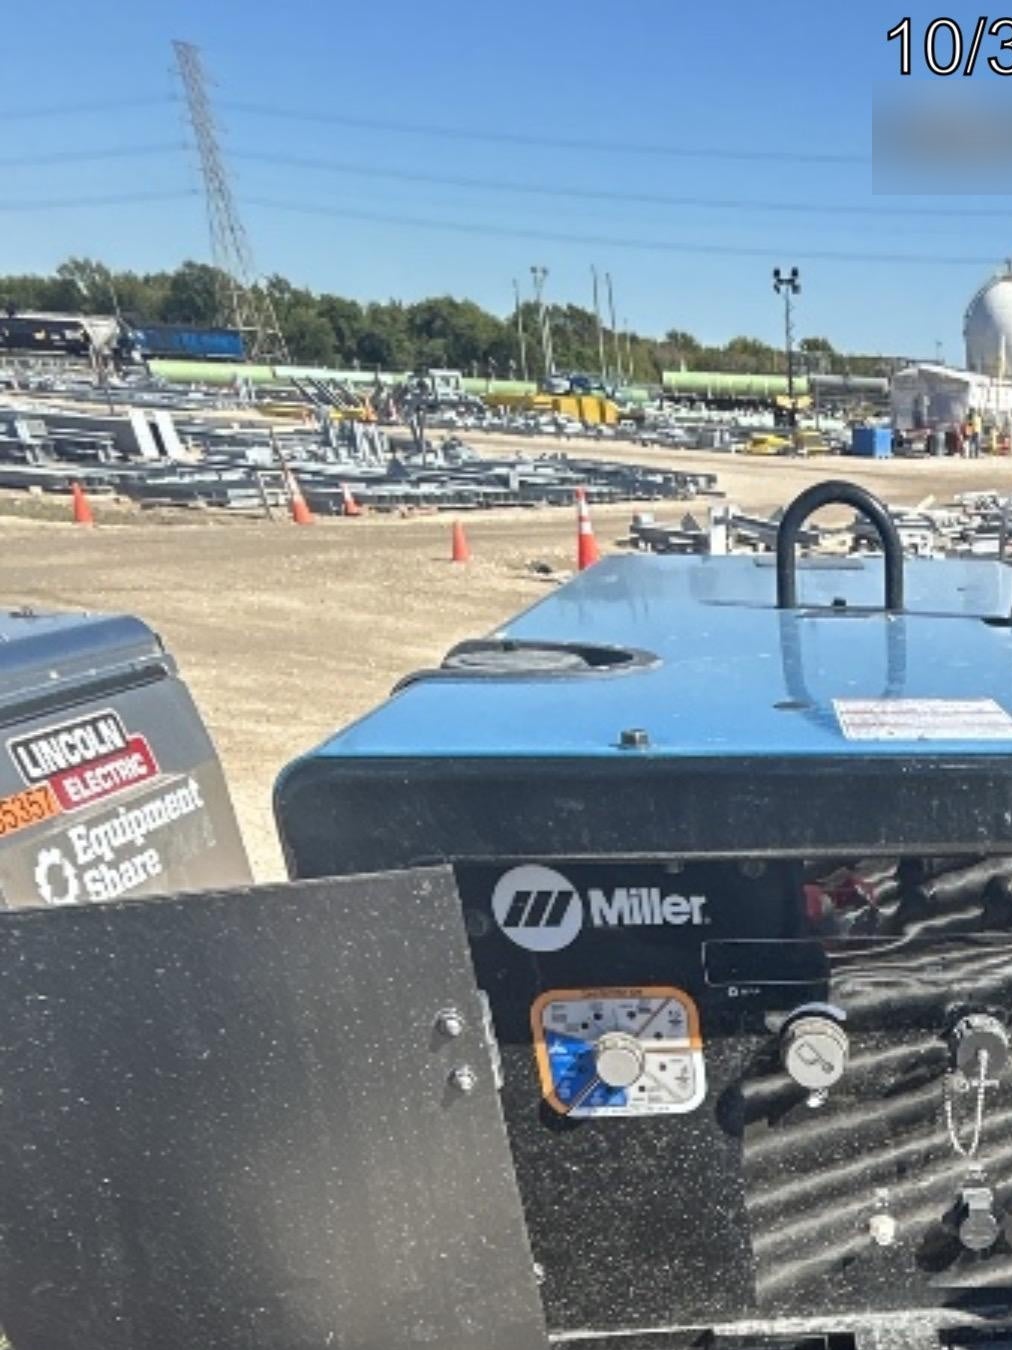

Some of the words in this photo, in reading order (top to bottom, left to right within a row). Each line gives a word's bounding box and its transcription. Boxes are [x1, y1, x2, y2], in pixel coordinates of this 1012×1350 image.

[17, 717, 126, 779] LINCOLN
[62, 753, 149, 801] ELECTRIC
[69, 776, 204, 865] Equipment
[83, 847, 163, 901] Share
[587, 886, 707, 928] Miller
